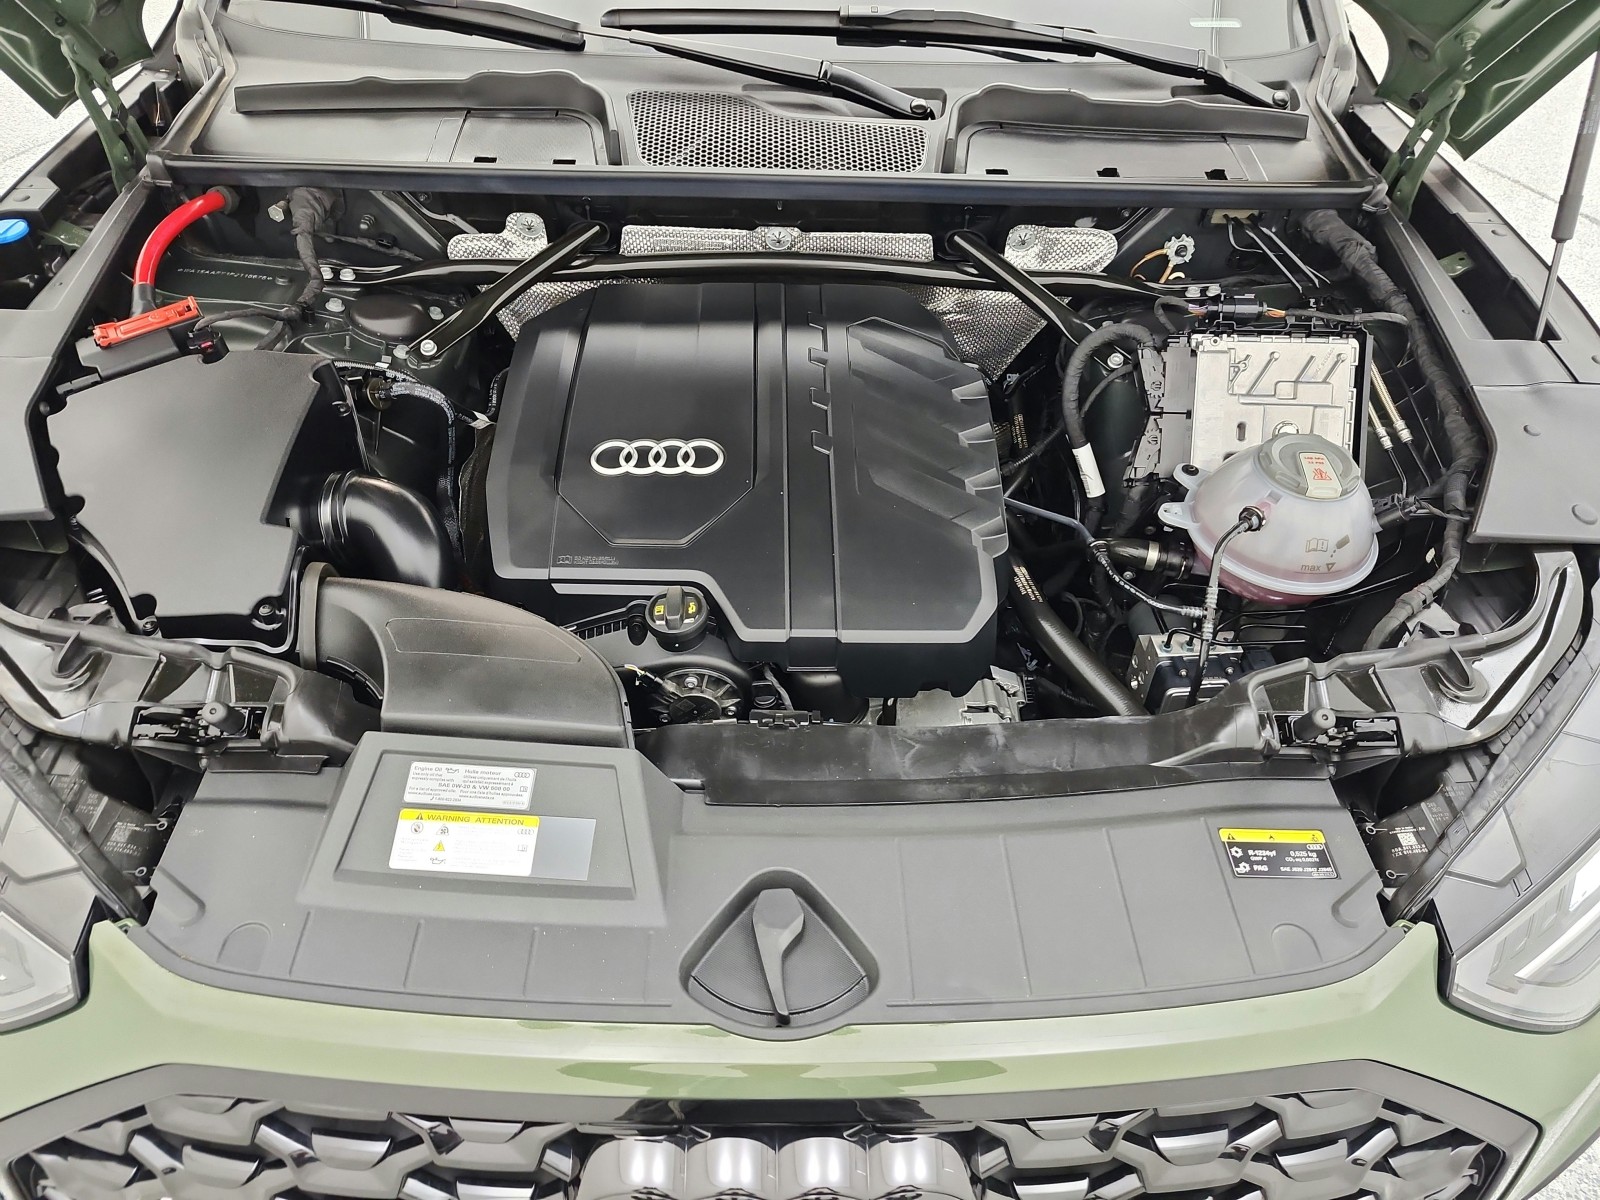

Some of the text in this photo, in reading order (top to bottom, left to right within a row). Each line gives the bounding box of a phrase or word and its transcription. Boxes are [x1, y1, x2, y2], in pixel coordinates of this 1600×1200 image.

[1300, 563, 1321, 572] max
[427, 814, 525, 826] WARNING ATTENTION
[1247, 849, 1277, 857] R-1234yf
[1252, 864, 1269, 872] PAG
